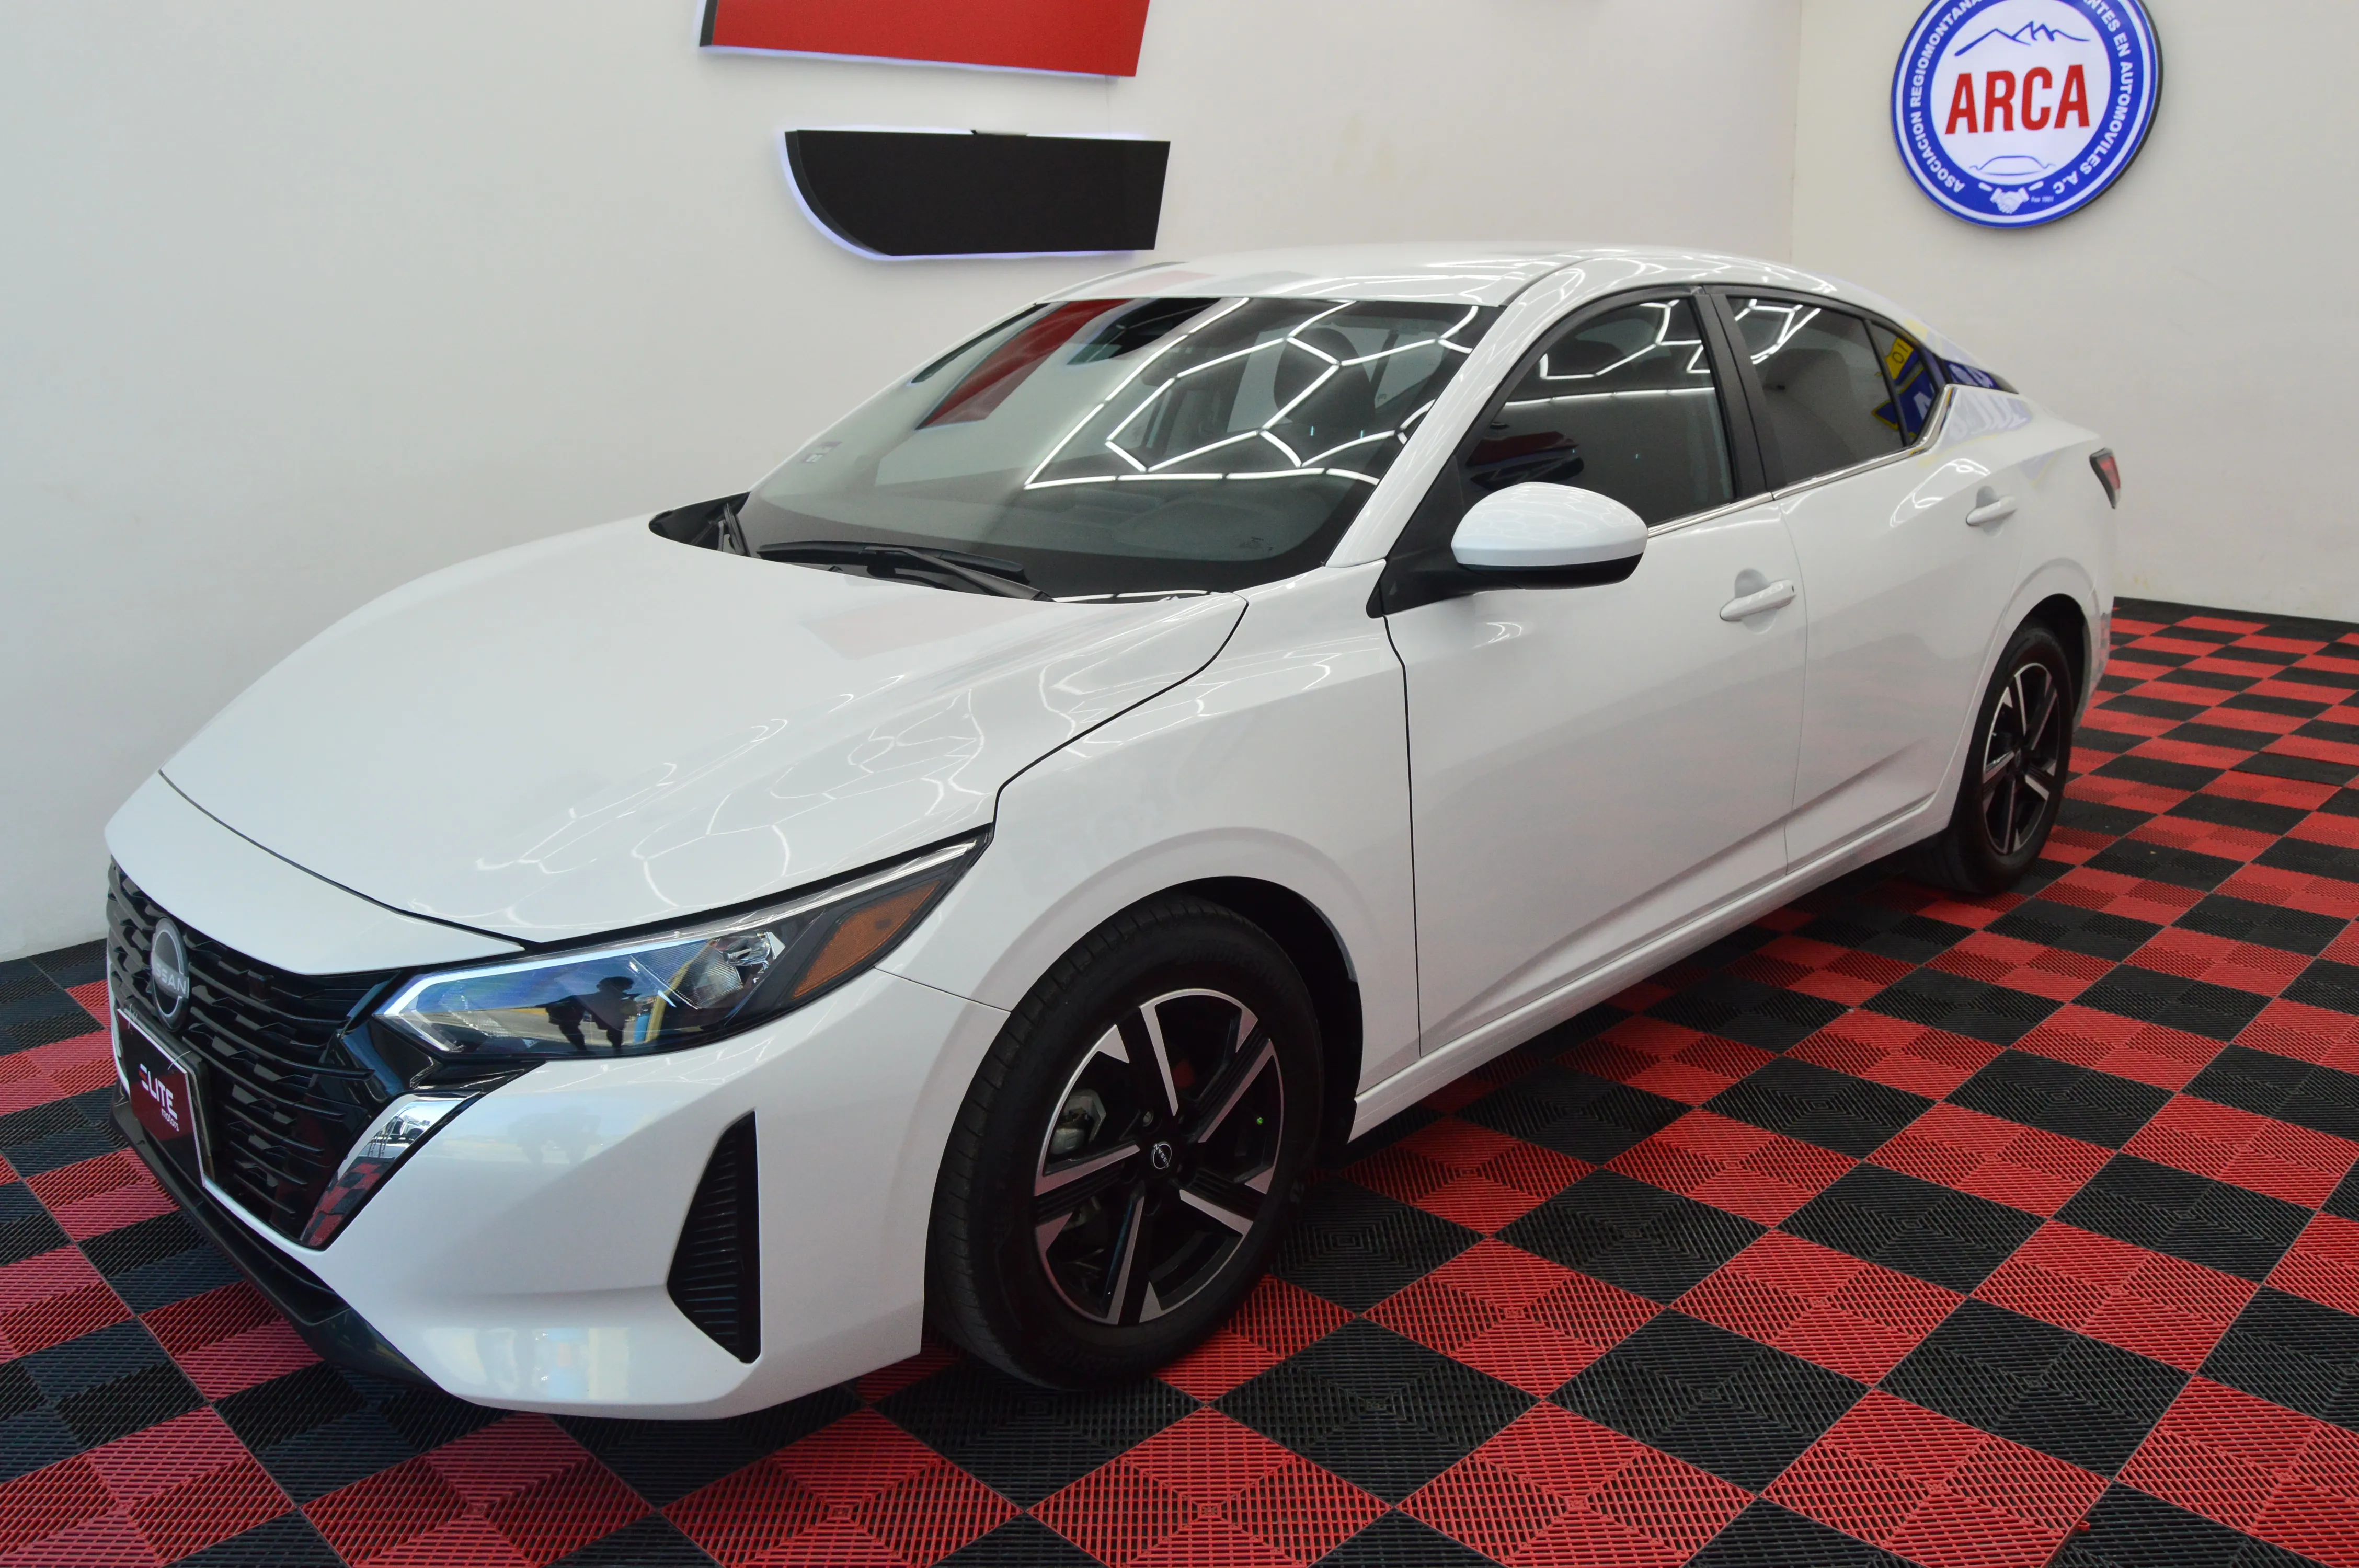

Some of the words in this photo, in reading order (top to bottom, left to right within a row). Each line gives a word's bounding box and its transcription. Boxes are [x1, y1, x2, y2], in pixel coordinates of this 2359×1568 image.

[2113, 32, 2132, 57] EN
[1944, 64, 2090, 135] ARCA
[2080, 61, 2134, 175] AUTOMOVILES
[1910, 110, 1966, 193] ASOCIACION
[2053, 171, 2078, 194] A.C
[152, 960, 187, 995] SSAN
[138, 1063, 178, 1120] ELITE
[162, 1108, 179, 1132] motors
[1153, 1143, 1170, 1168] NISSAN
